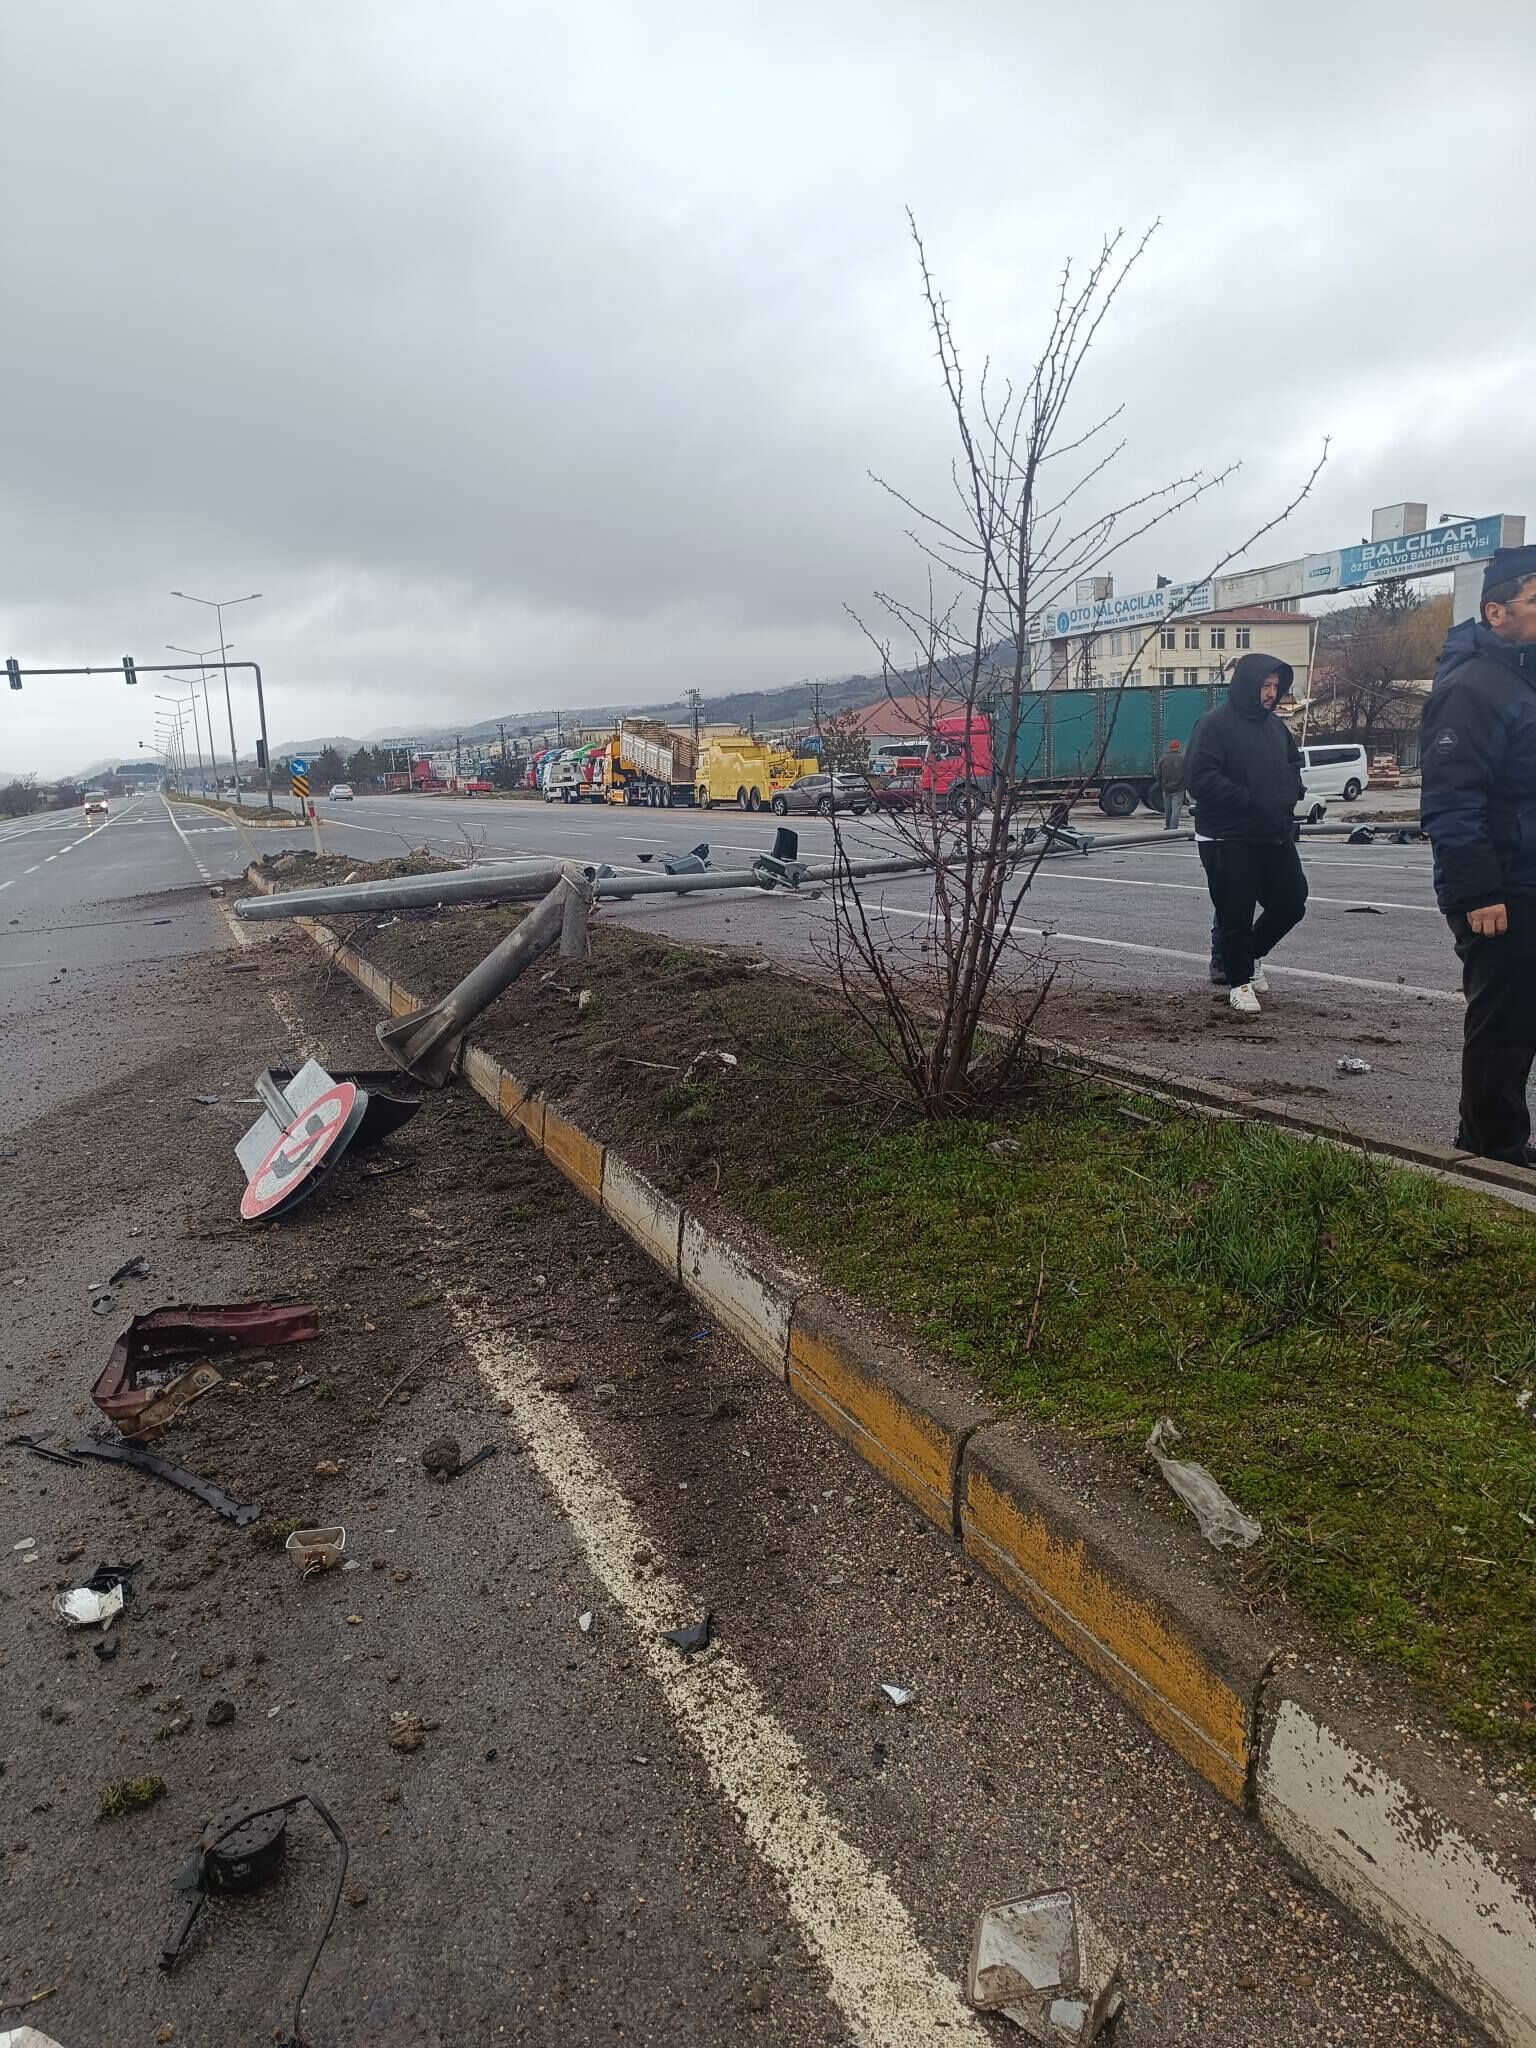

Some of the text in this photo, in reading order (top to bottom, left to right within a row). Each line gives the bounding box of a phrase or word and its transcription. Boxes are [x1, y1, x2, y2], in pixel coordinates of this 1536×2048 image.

[1351, 535, 1489, 573] ÖZEL VOLVO BAKIM SERVİSİ
[1362, 524, 1477, 561] BALCILAR
[1070, 607, 1090, 622] OTO
